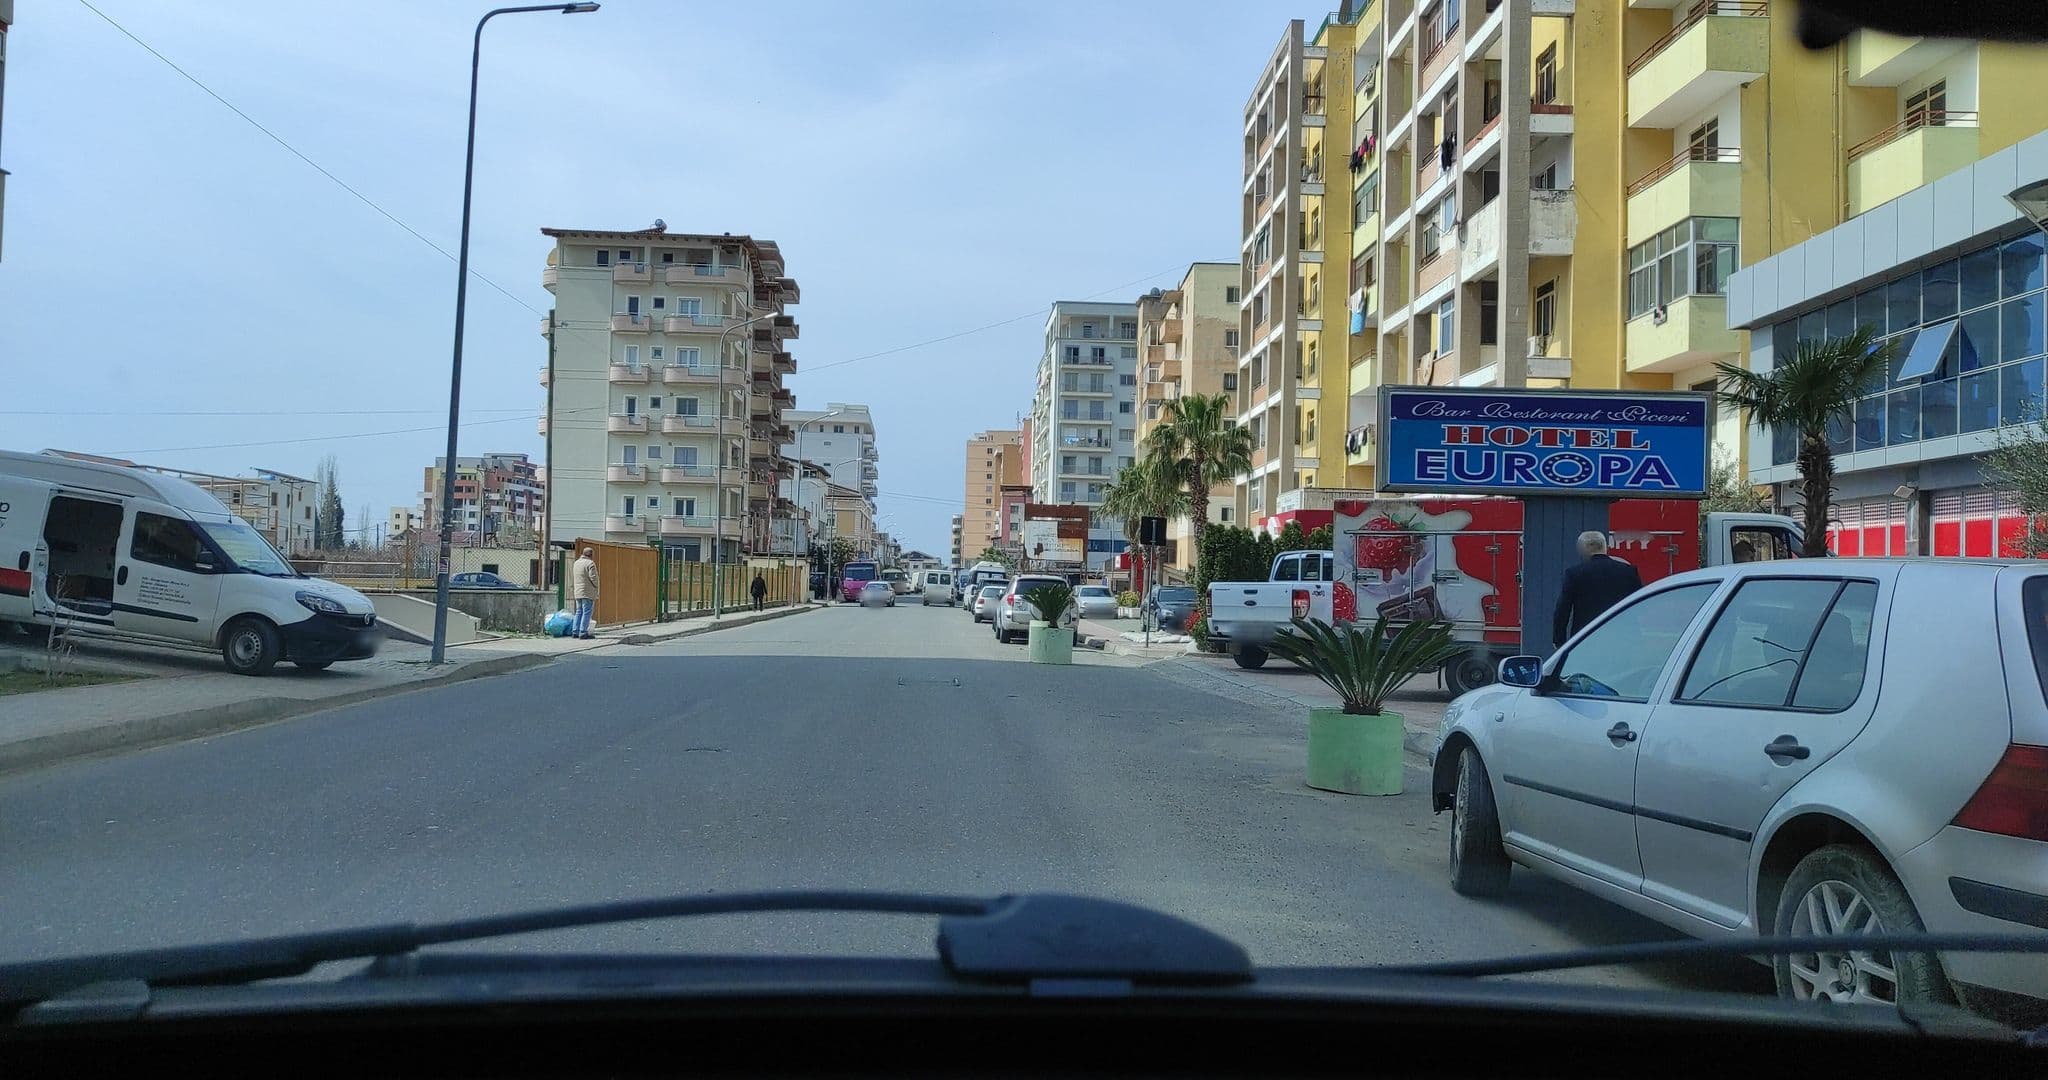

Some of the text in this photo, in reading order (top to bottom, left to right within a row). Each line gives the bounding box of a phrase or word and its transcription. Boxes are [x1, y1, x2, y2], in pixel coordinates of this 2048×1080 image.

[1411, 400, 1690, 423] Bar Restorant Piceri
[1441, 424, 1650, 450] HOTEL
[1415, 448, 1680, 488] EUROPA
